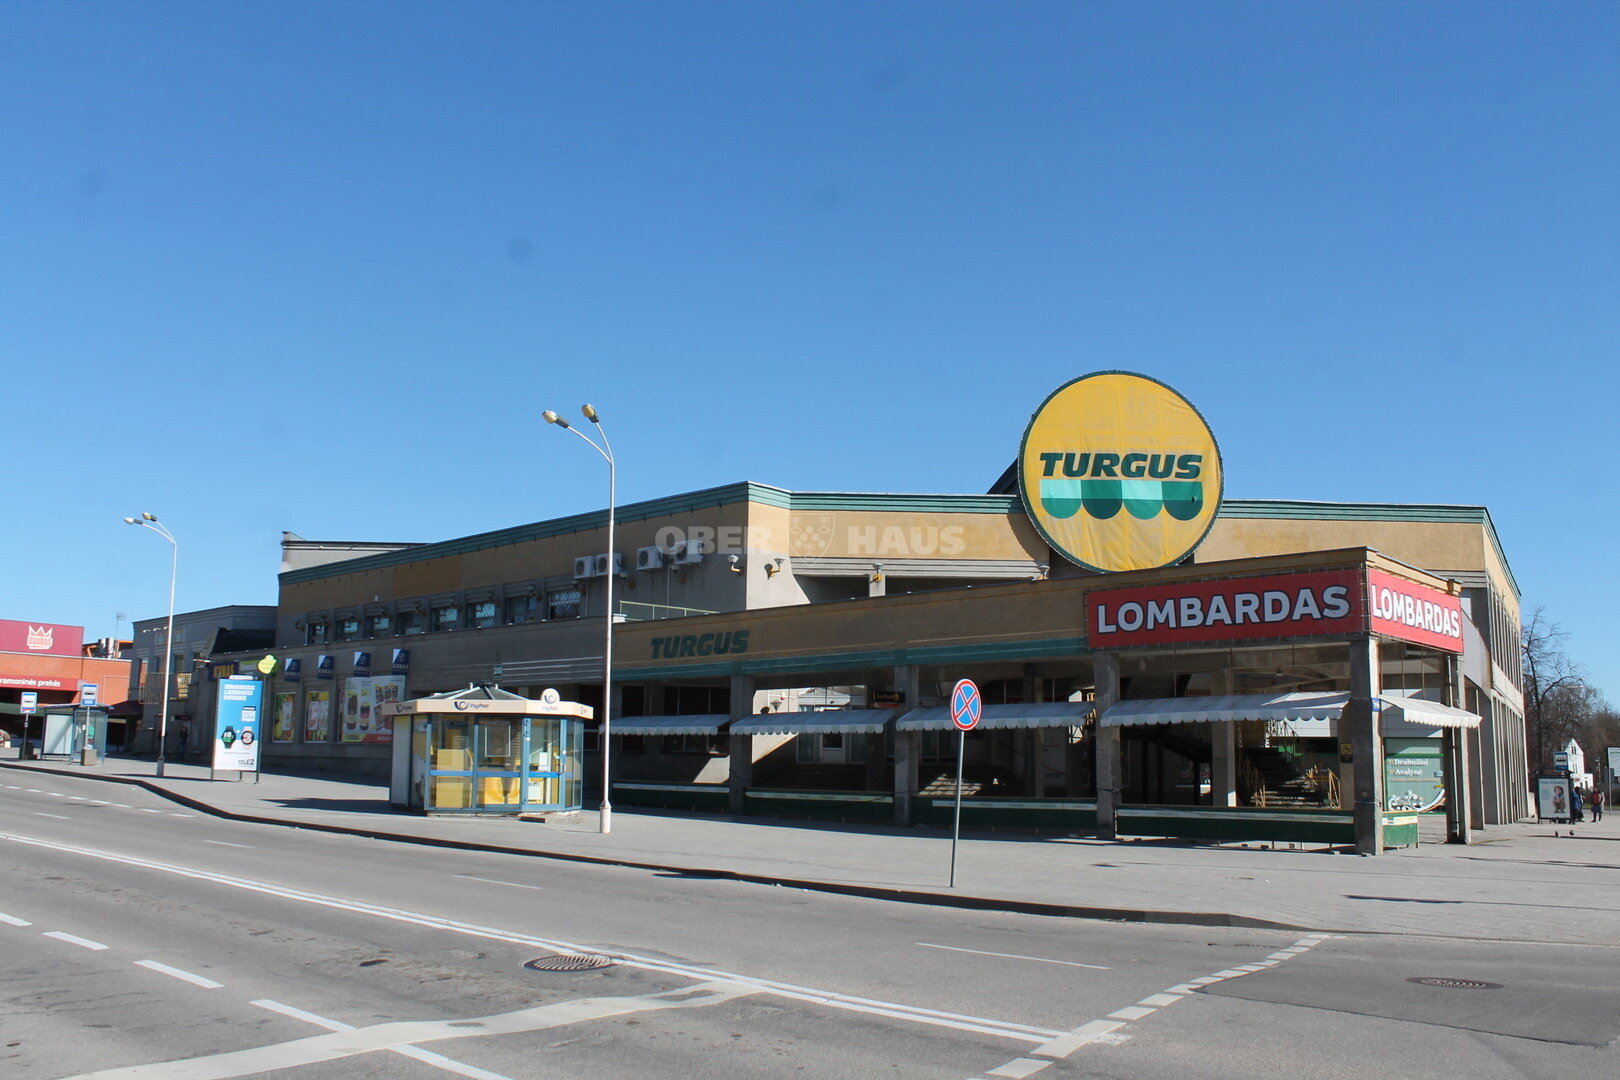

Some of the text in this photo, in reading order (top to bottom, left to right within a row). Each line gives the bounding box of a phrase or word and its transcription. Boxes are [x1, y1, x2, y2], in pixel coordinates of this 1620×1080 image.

[1040, 452, 1202, 479] TURGUS
[1097, 585, 1350, 634] LOMBARDAS
[1370, 584, 1460, 639] LOMBARDAS
[651, 630, 749, 660] TURGUS
[1395, 768, 1423, 776] Avalynė
